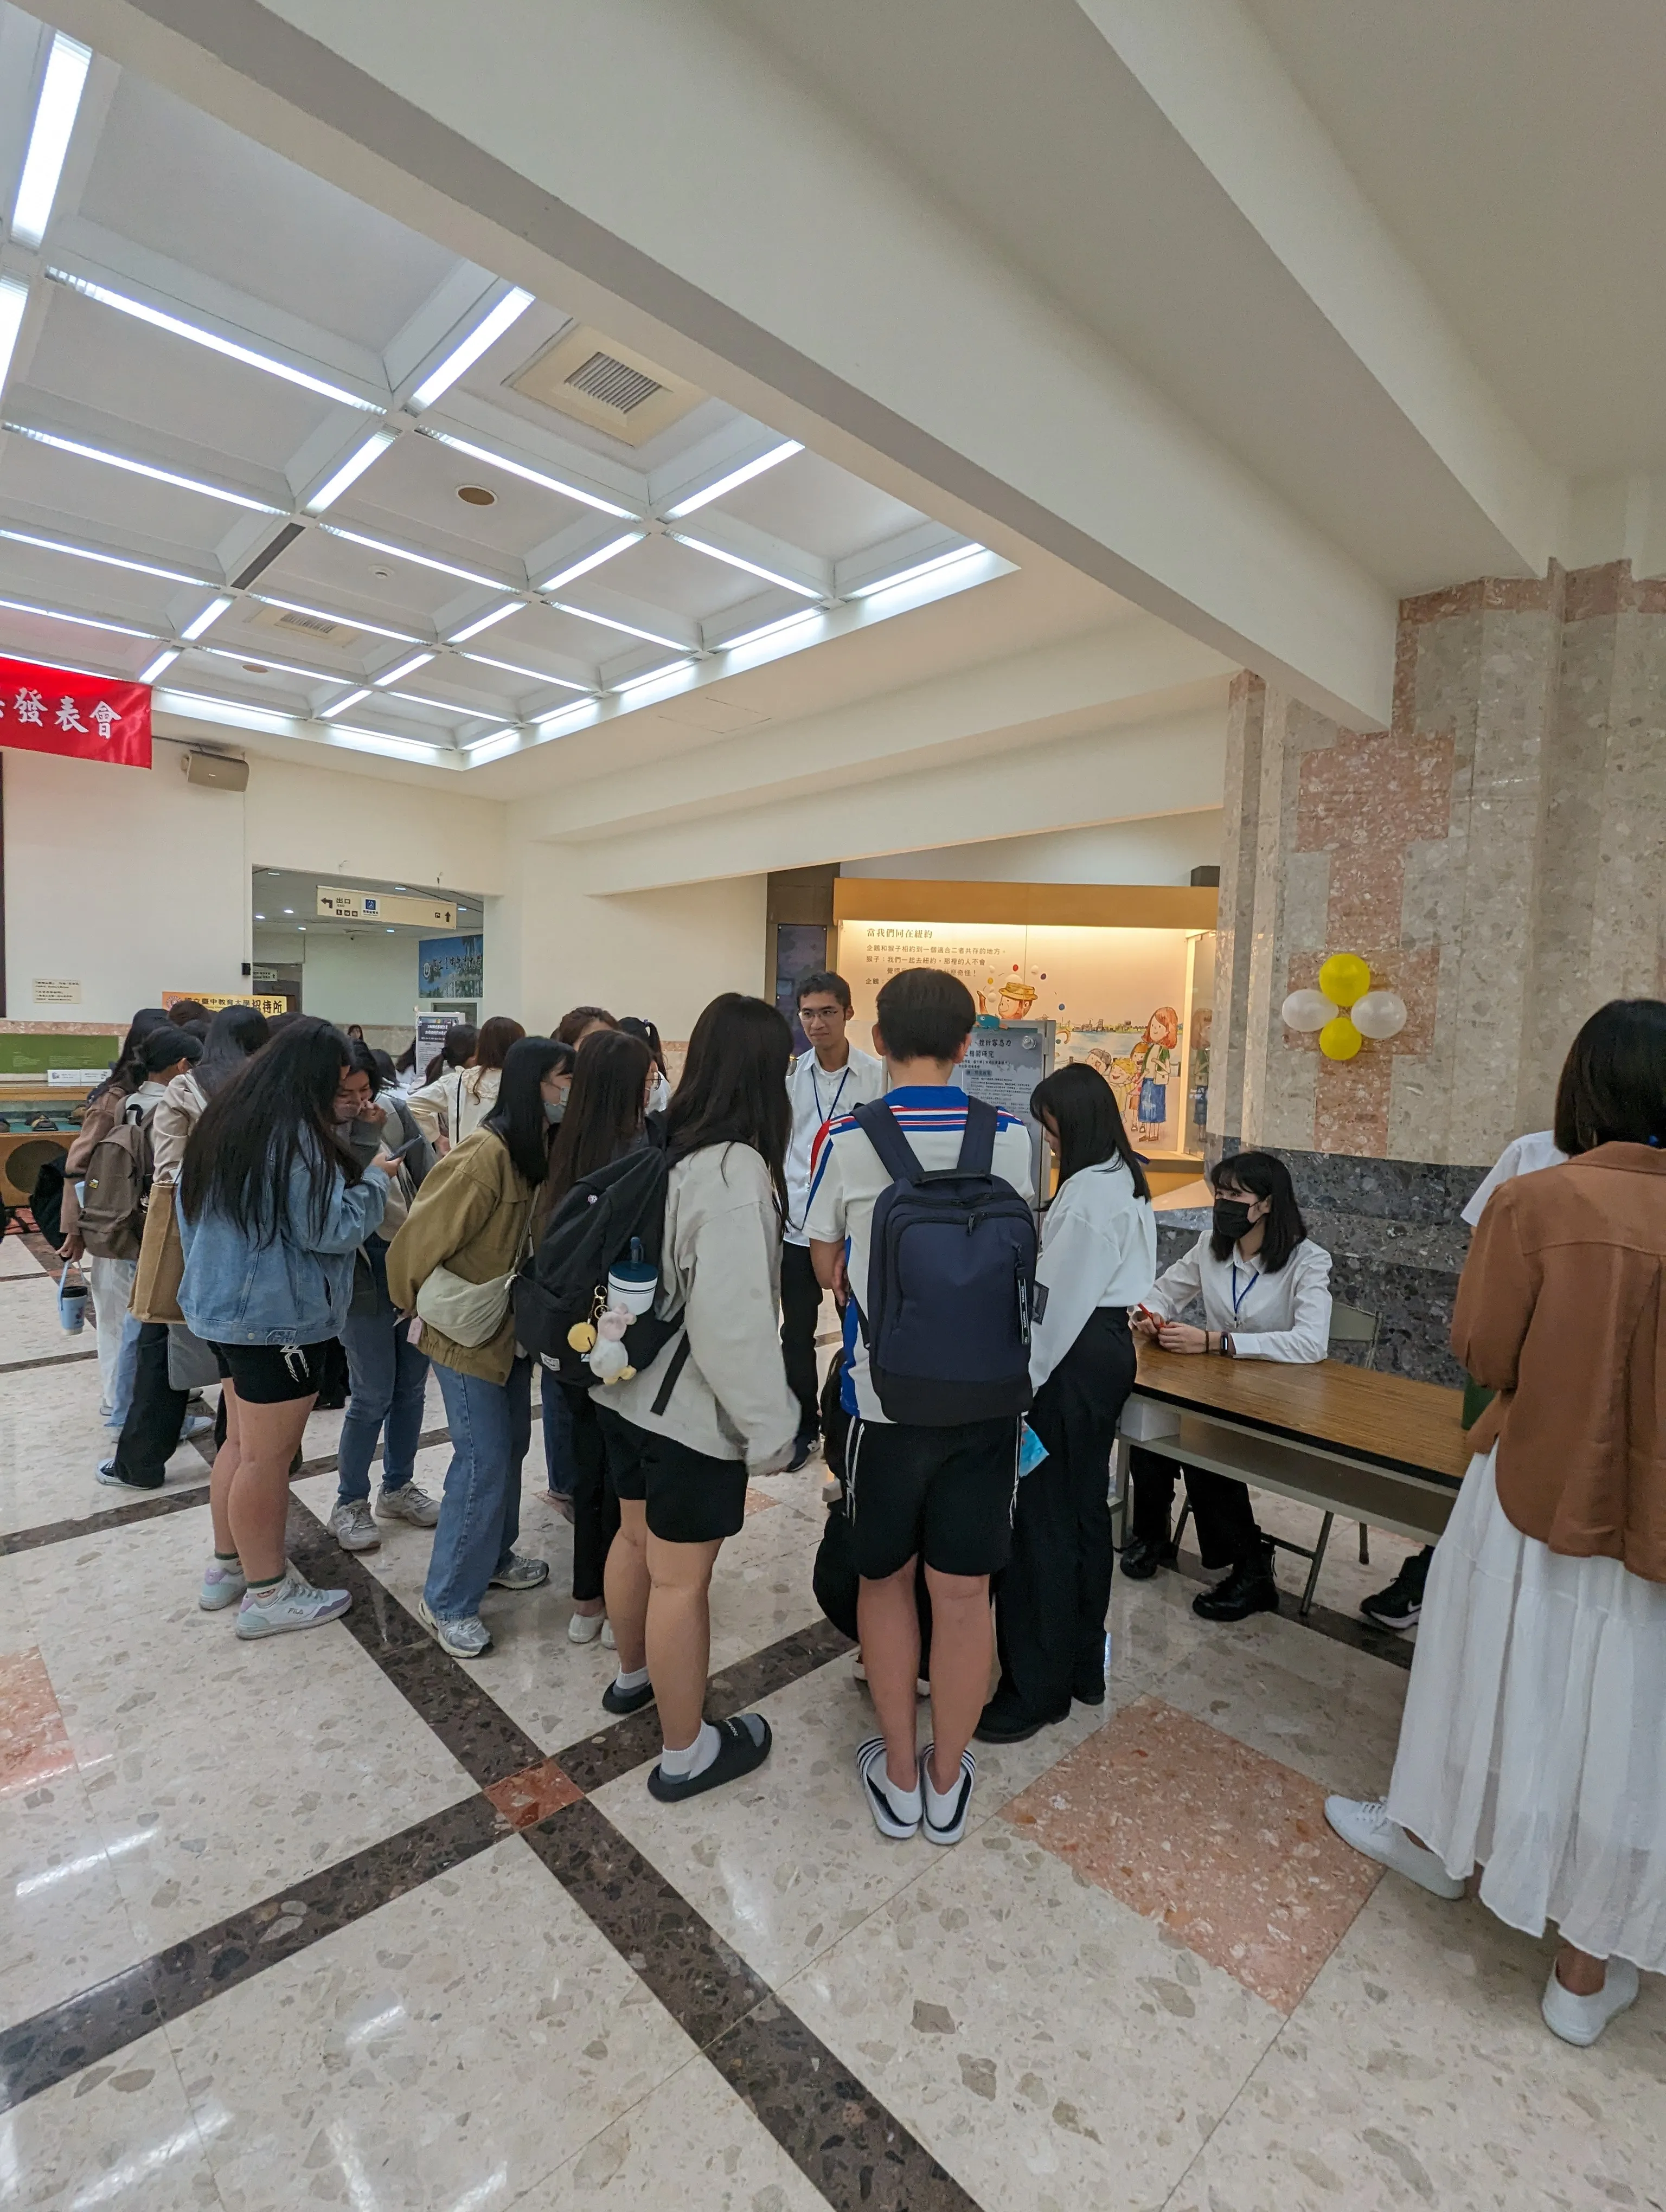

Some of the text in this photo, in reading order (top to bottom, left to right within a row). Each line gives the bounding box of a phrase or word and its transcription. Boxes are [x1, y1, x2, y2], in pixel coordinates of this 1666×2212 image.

[0, 687, 122, 739] 發表會
[867, 928, 932, 938] 當我們同在紐約
[252, 999, 282, 1013] 招待所
[965, 1050, 995, 1058] 相關研究
